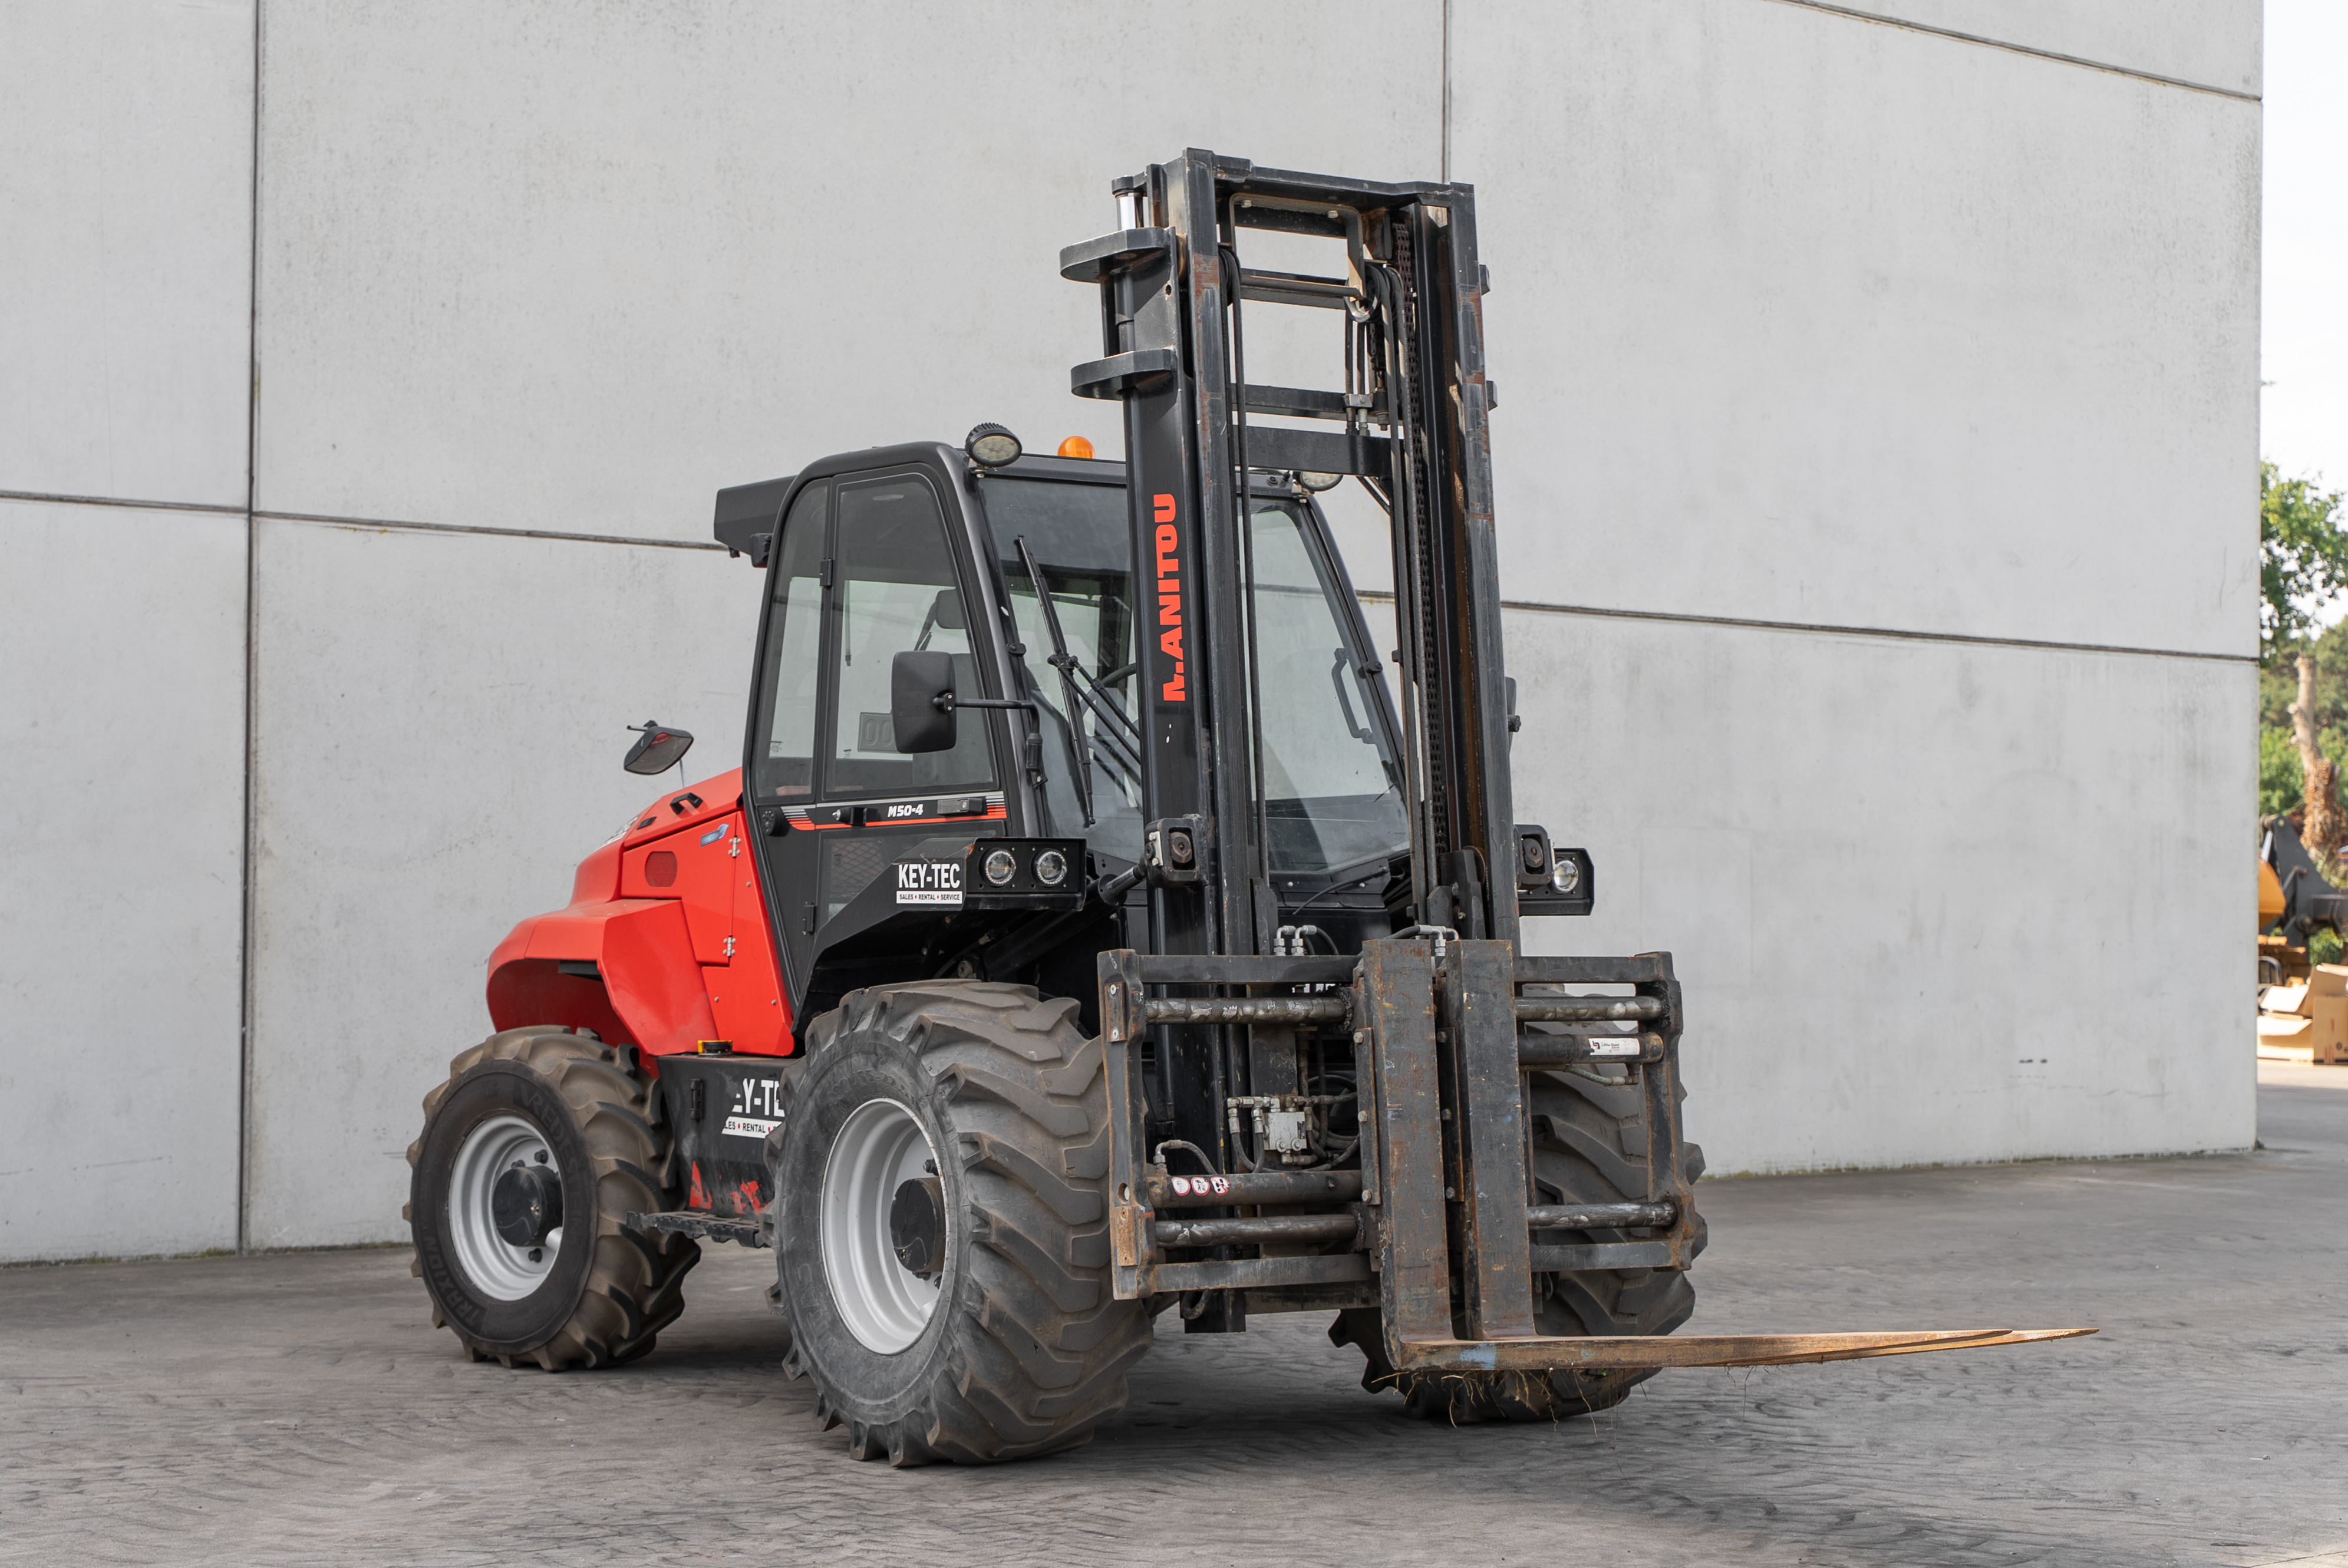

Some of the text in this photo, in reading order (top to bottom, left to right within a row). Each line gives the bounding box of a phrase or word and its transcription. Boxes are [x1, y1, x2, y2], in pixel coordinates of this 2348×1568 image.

[1153, 493, 1186, 702] MANITOU
[888, 804, 924, 817] M50-4
[898, 863, 961, 889] KEY-TEC
[742, 1123, 766, 1133] RENTAL
[423, 1237, 480, 1327] TRAXION
